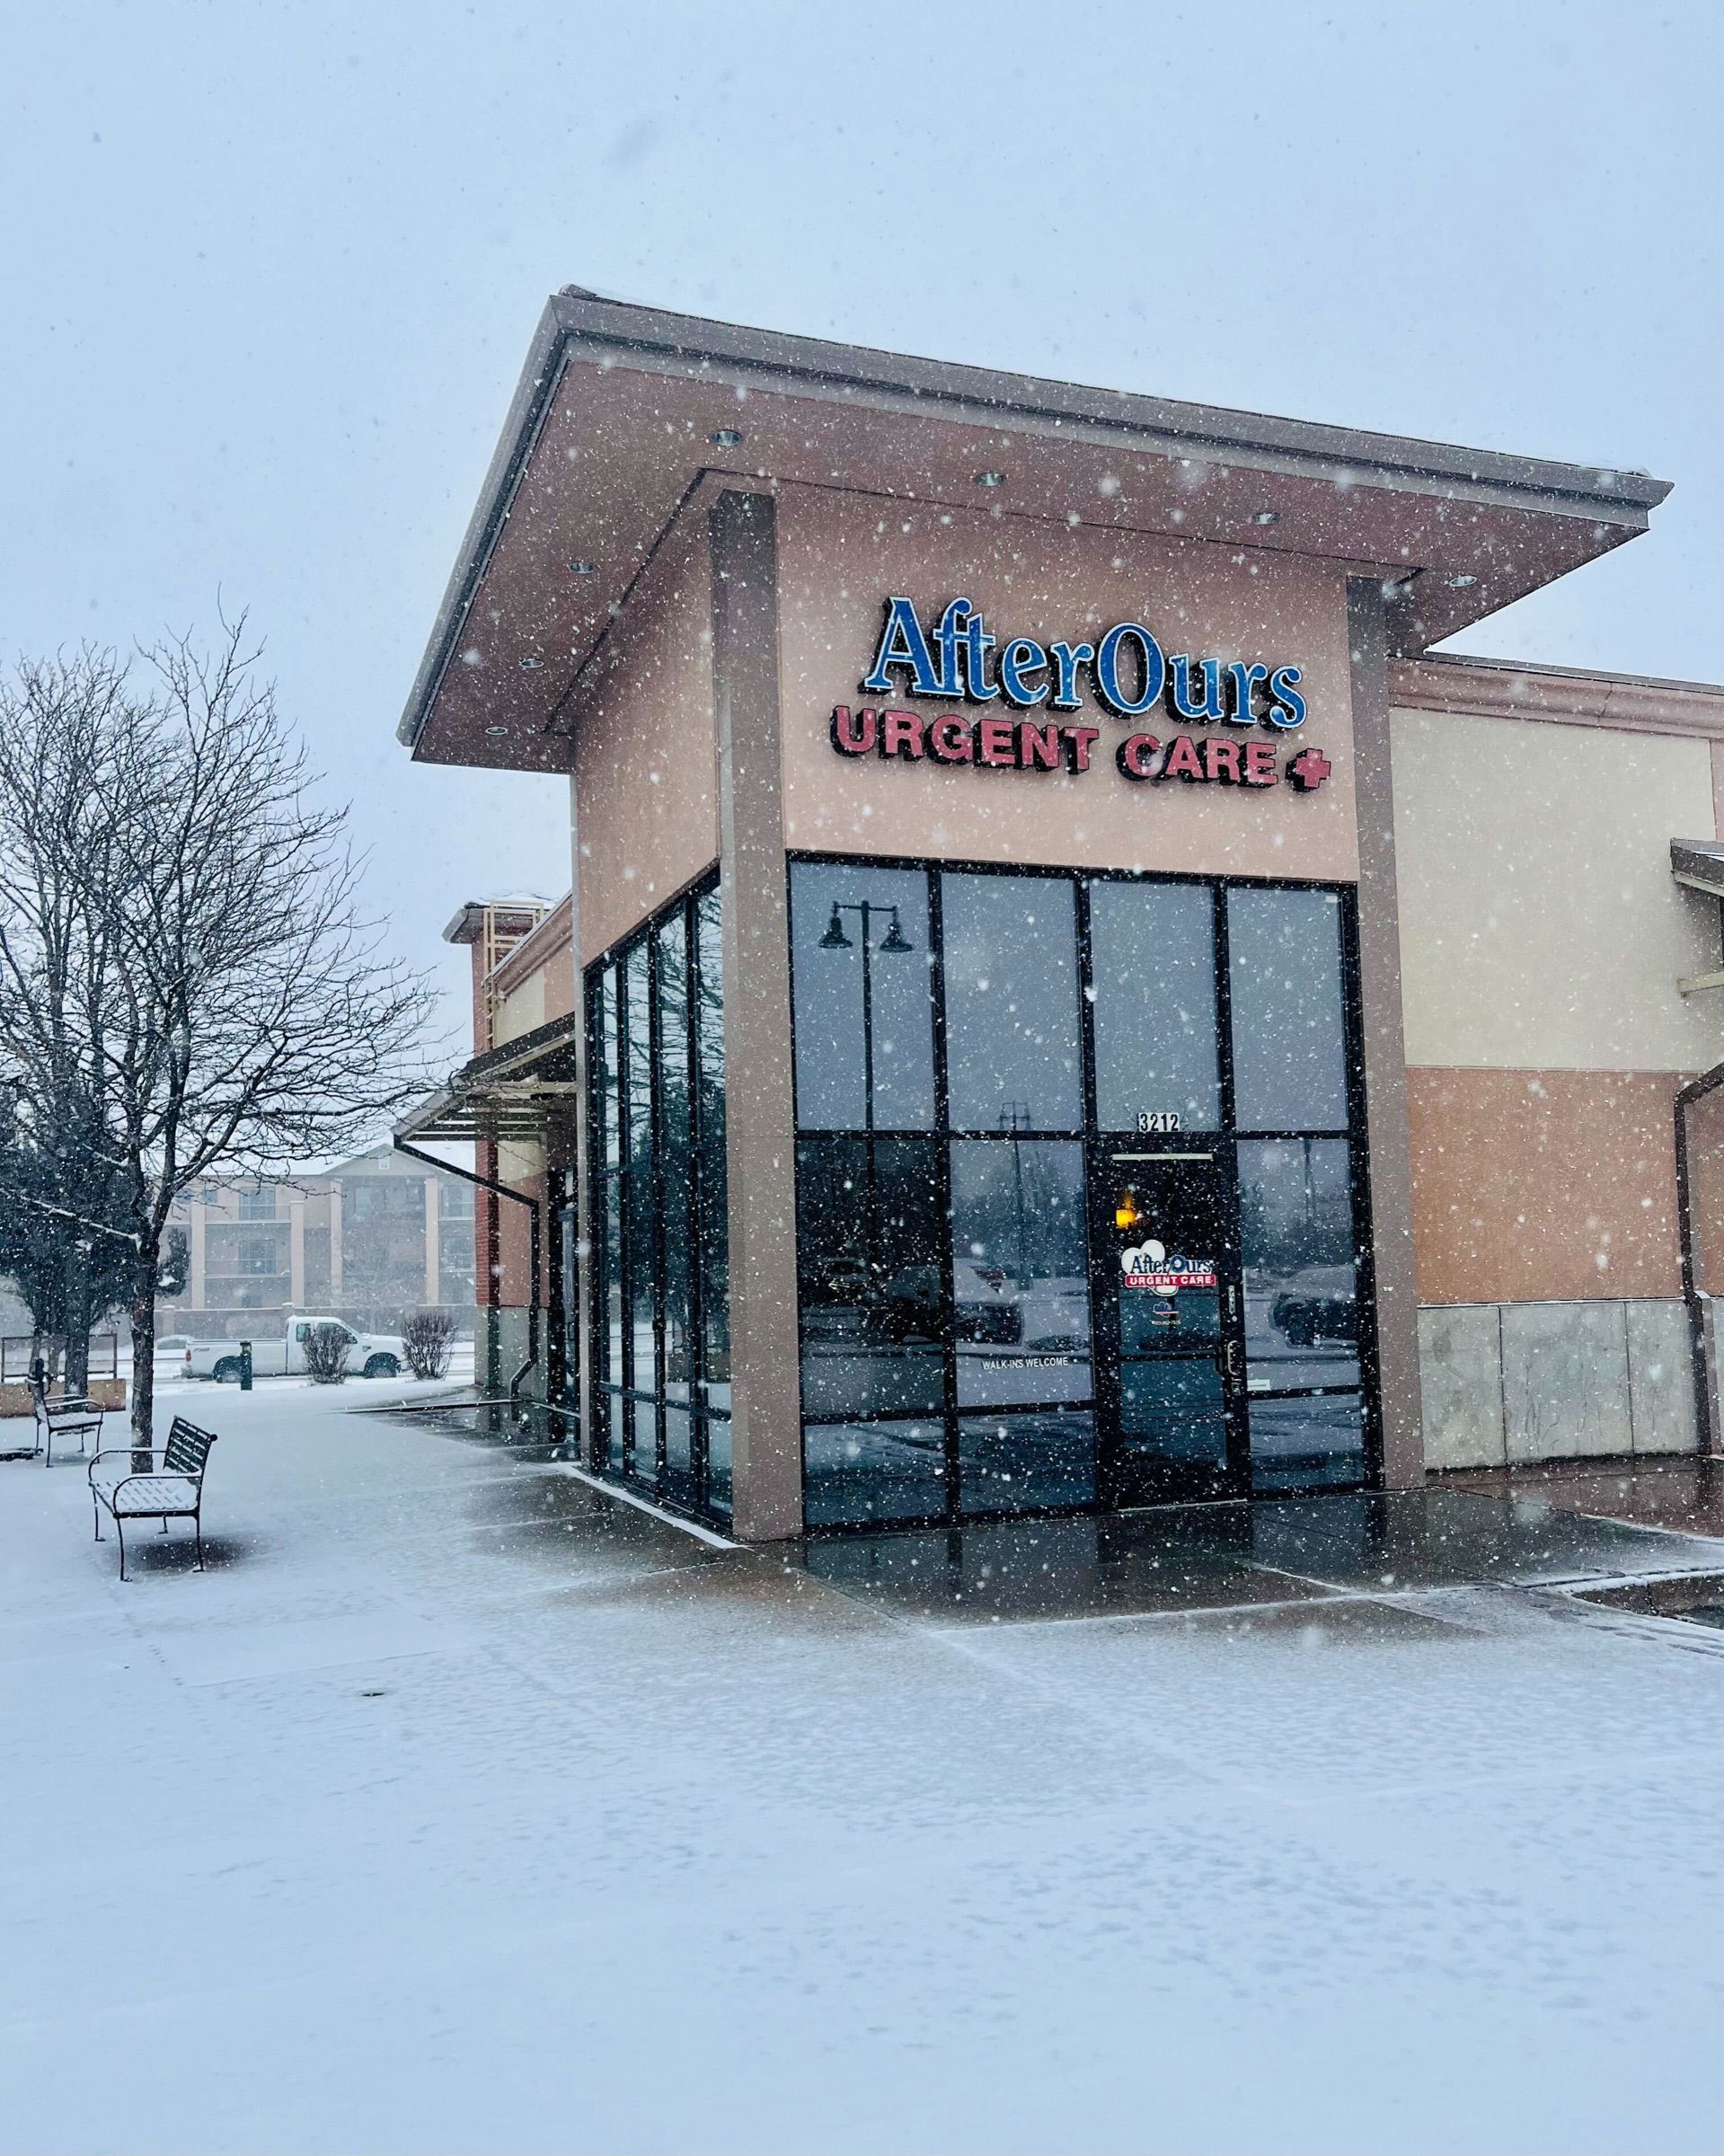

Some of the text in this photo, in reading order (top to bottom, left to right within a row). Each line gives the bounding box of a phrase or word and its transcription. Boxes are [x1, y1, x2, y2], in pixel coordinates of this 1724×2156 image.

[862, 595, 1308, 729] AfterOurs
[834, 705, 1279, 785] URGENT CARE
[1139, 1113, 1180, 1132] 3212
[1129, 1253, 1212, 1275] AfterOurs
[1129, 1276, 1213, 1286] URGENT CARE
[982, 1356, 1069, 1370] WALK-INS WELCOME
